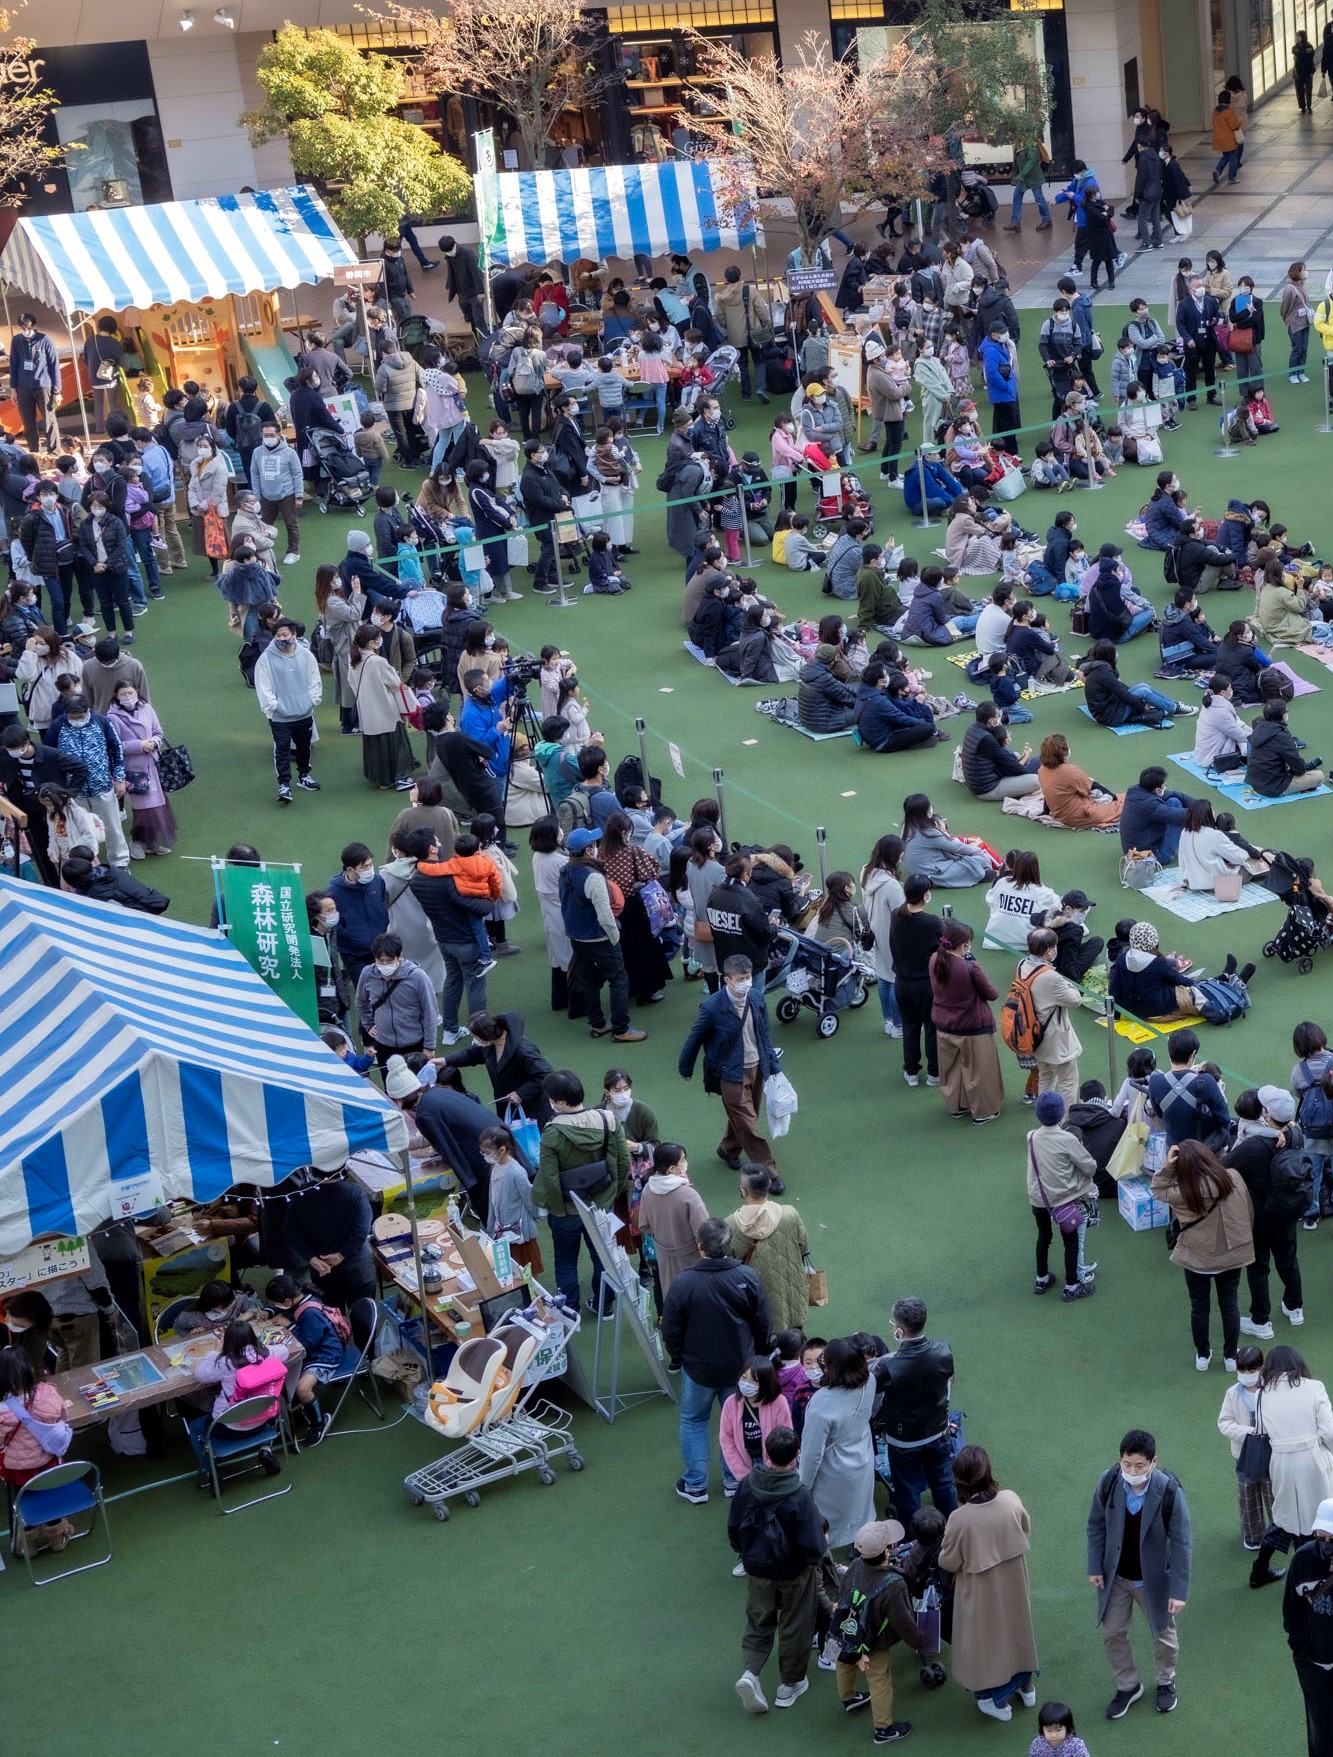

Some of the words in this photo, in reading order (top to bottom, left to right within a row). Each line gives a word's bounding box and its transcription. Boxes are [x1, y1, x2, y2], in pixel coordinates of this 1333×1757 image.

[345, 269, 372, 280] 静岡市
[251, 882, 280, 979] 森林研究
[280, 886, 303, 980] 国立研究開発法人
[999, 894, 1035, 916] DIESEL
